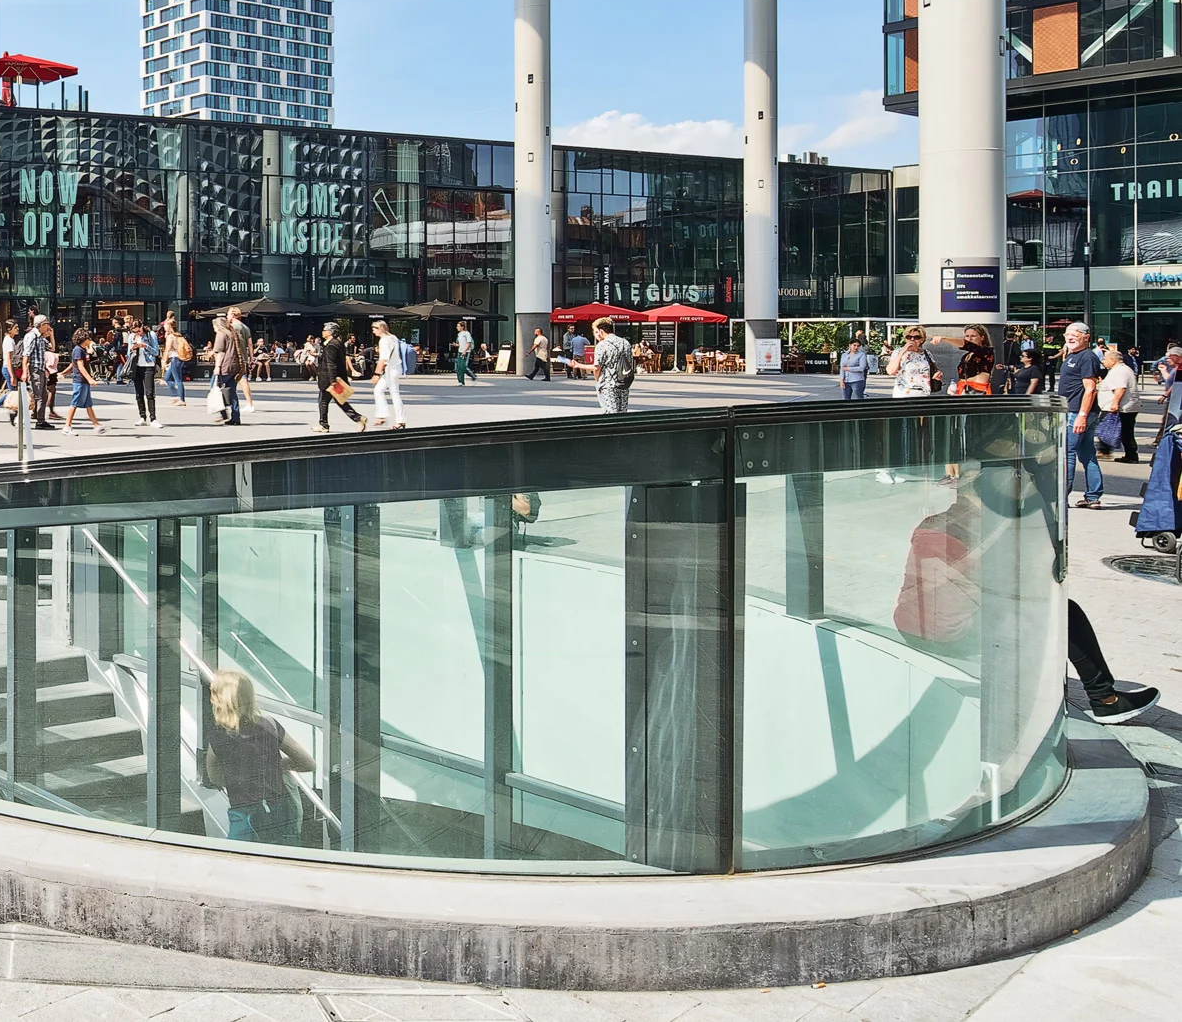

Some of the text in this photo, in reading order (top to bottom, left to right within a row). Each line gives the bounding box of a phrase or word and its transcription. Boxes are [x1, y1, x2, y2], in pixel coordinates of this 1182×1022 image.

[19, 168, 79, 206] NOW
[281, 183, 340, 218] COME
[23, 211, 89, 248] OPEN
[271, 220, 344, 256] INSIDE
[646, 283, 700, 303] GUYS
[799, 289, 812, 297] BAR
